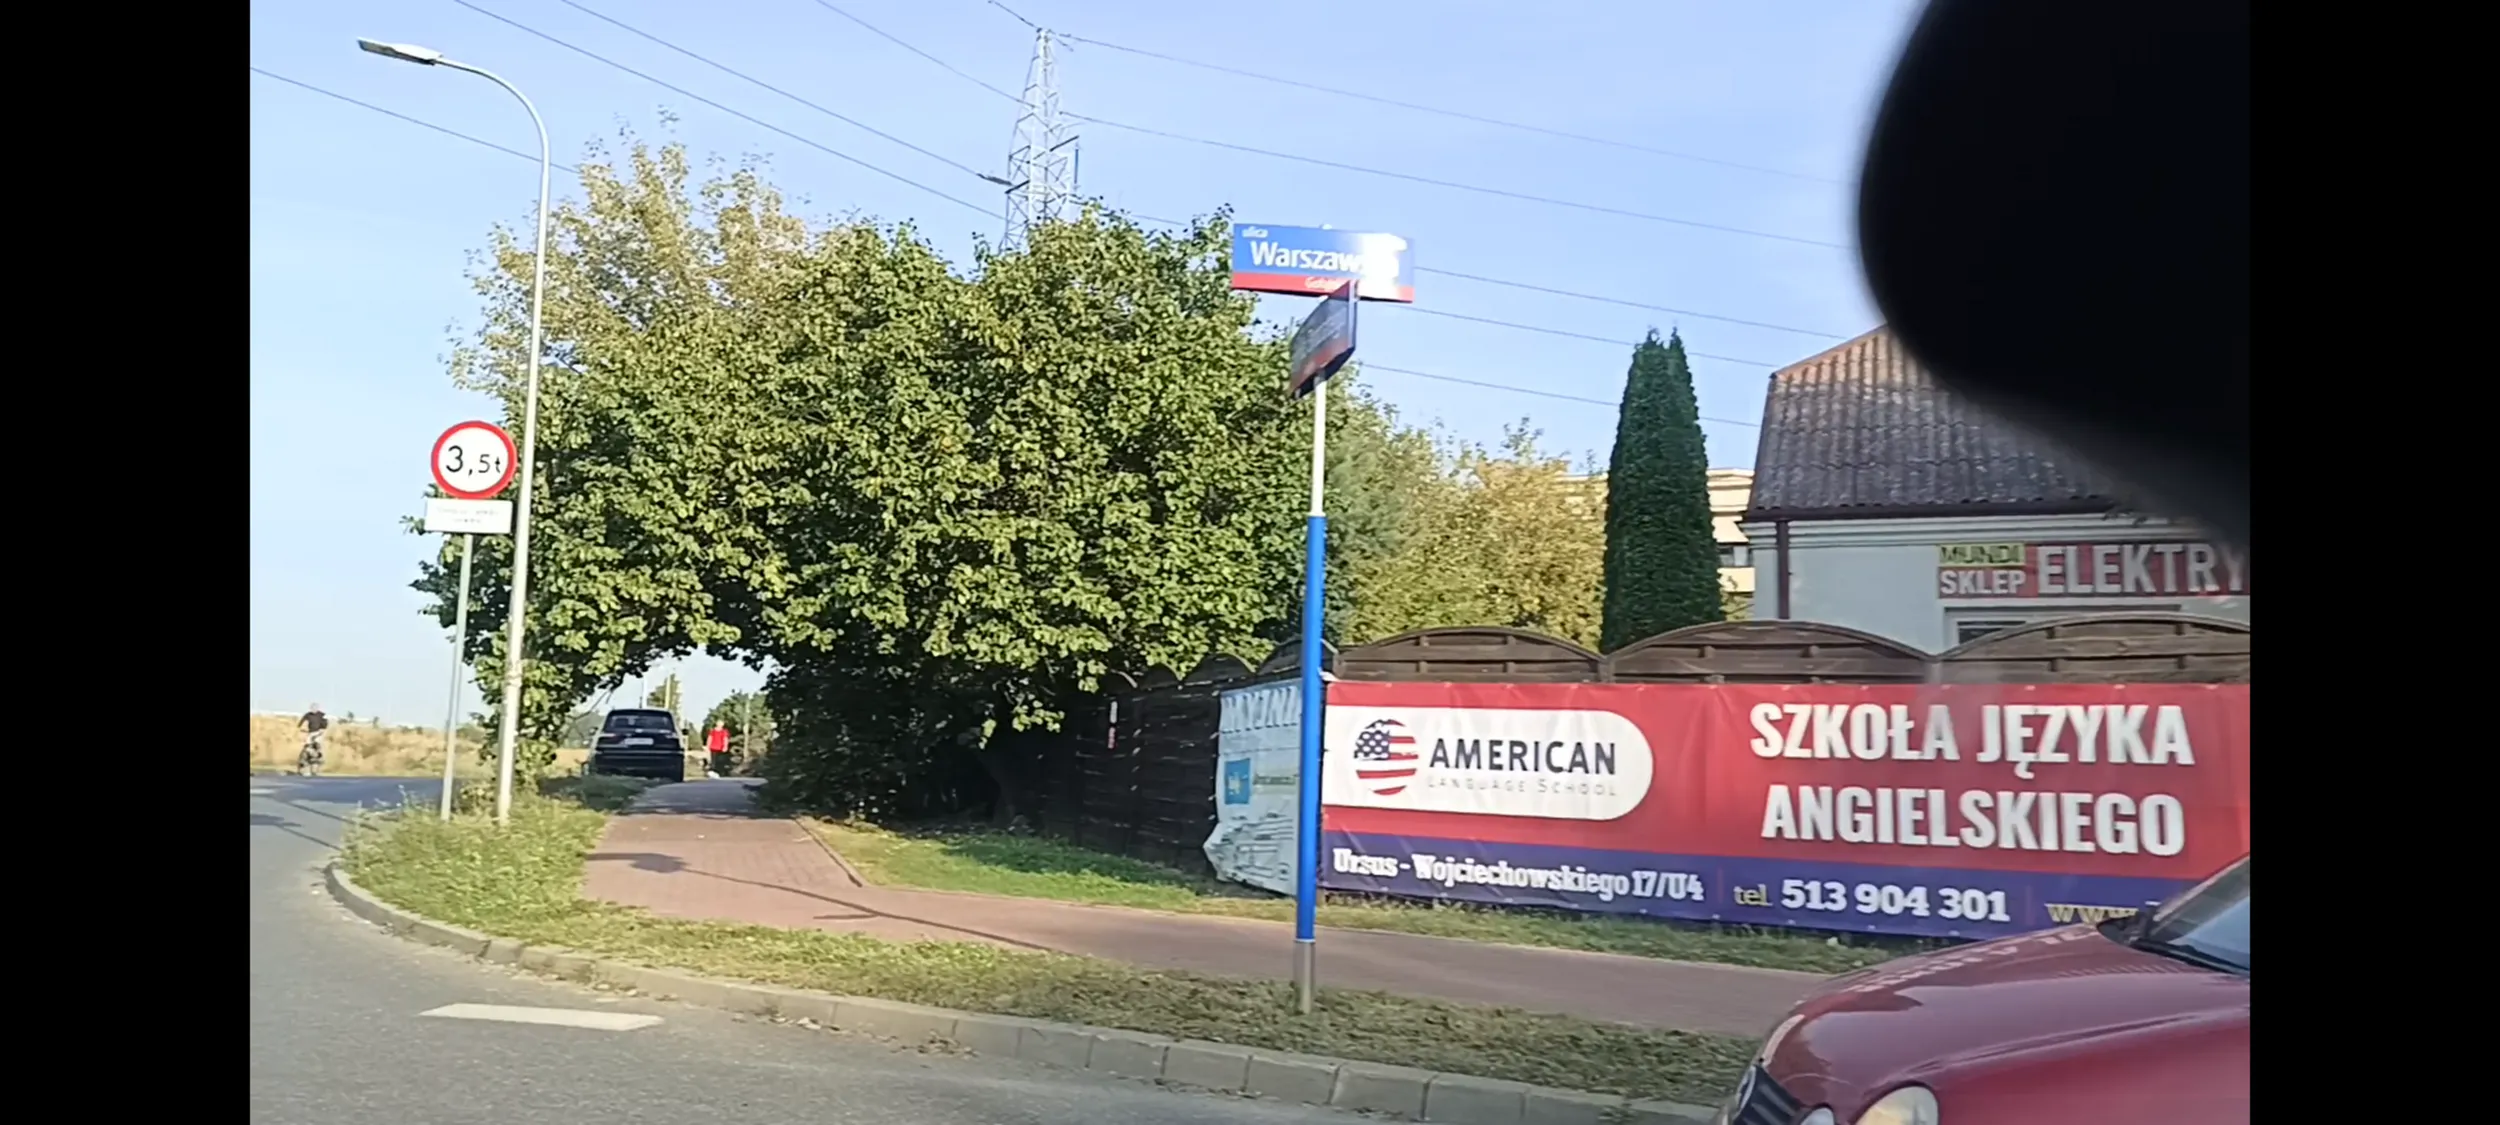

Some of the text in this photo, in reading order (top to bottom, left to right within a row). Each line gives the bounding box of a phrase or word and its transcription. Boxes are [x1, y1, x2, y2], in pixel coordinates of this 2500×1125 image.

[1250, 240, 1378, 274] Warszaw
[1940, 570, 2026, 595] SKLEP
[1429, 738, 1616, 776] AMERICAN
[1749, 702, 2195, 779] SZKOŁA JĘZYKA
[1760, 785, 2186, 857] ANGIELSKIEGO
[1332, 848, 1398, 877] Ursus
[1411, 853, 1629, 901] Wojciechowskiego
[1632, 869, 1704, 903] 17/U4
[1782, 879, 1847, 912] 513
[1855, 884, 1931, 917] 904
[1938, 888, 2011, 922] 301
